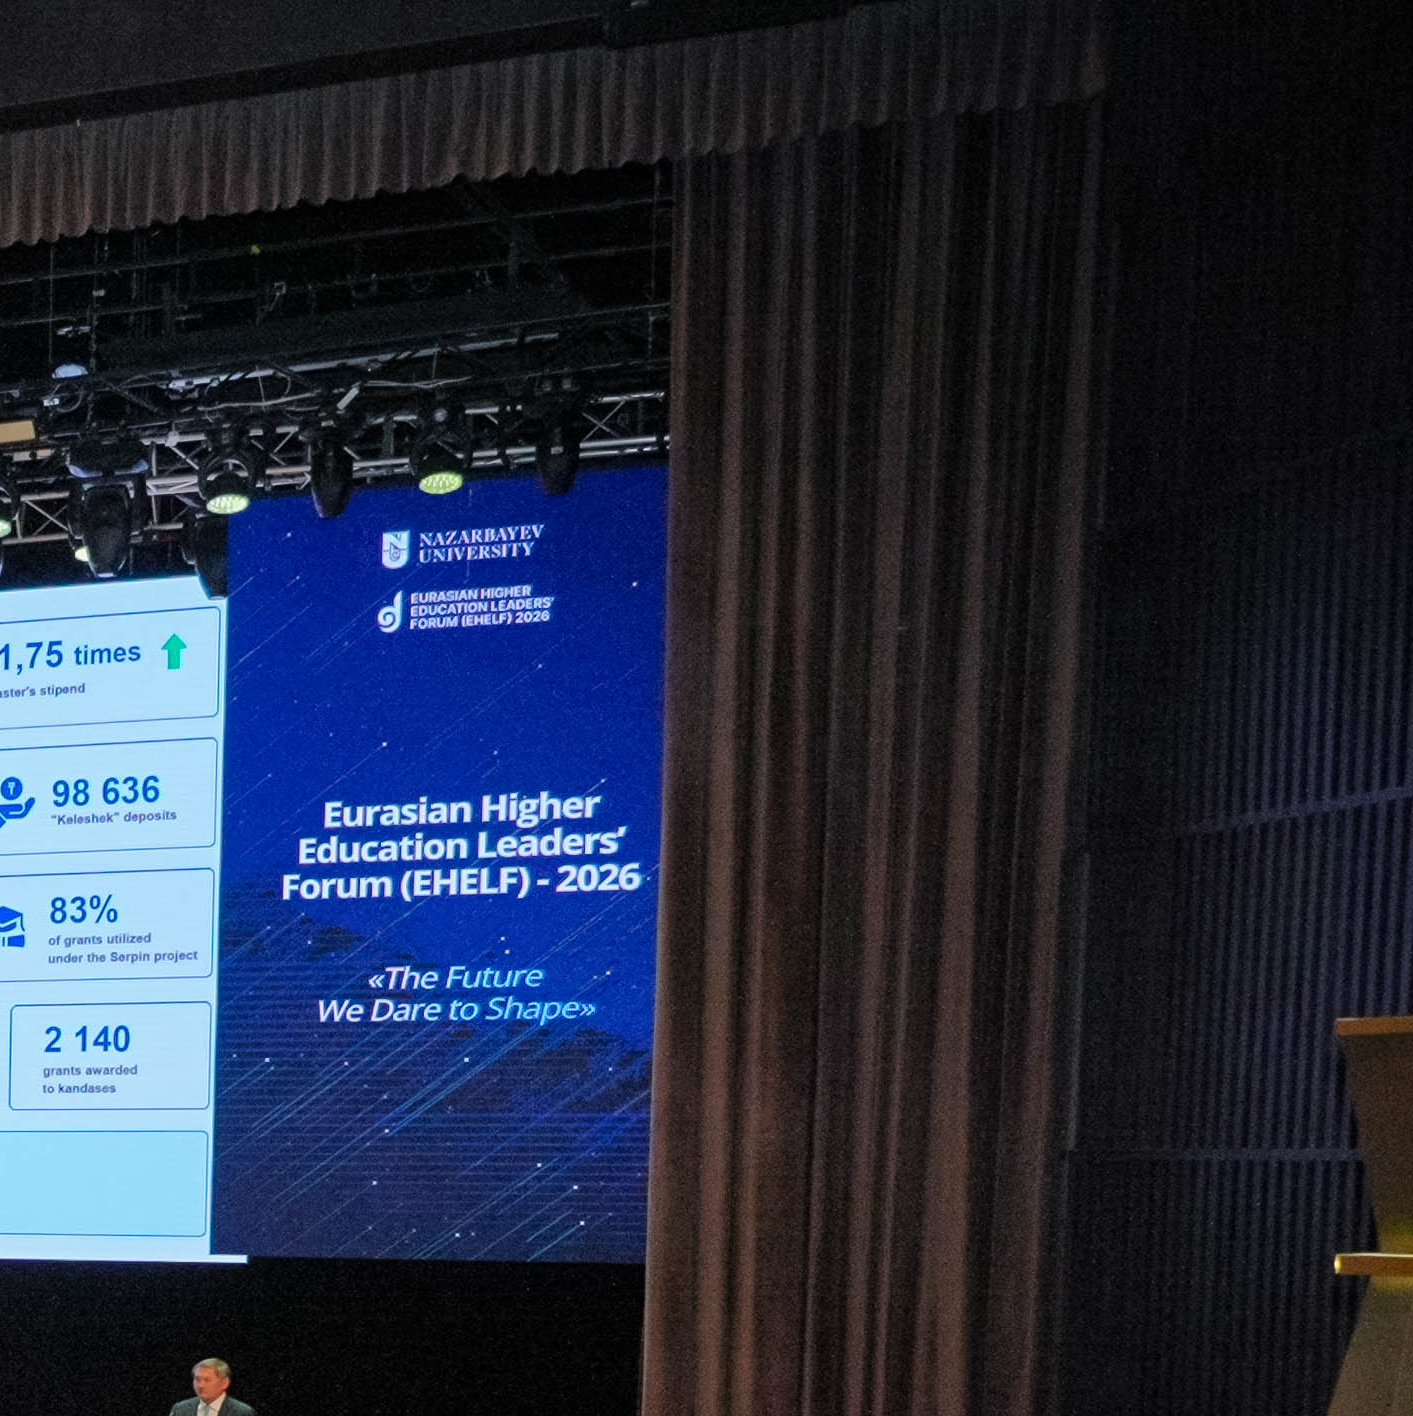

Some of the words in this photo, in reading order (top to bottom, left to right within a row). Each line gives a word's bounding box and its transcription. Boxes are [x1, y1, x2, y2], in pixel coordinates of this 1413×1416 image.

[419, 524, 545, 547] NAZARBAYEV
[419, 542, 535, 564] UNIVERSITY
[410, 588, 479, 605] EURASIAN
[481, 584, 532, 600] HIGHER
[410, 601, 488, 617] EDUCATION
[410, 615, 458, 630] FORUM
[461, 612, 512, 628] (EHELF)
[515, 610, 550, 624] 2026
[74, 641, 142, 667] times
[39, 683, 85, 699] stipend
[52, 779, 90, 808] 98
[101, 775, 160, 805] 636
[123, 809, 177, 826] deposits
[323, 797, 471, 830] Eurasian
[481, 792, 601, 831] Higher
[298, 831, 468, 866] Education
[282, 868, 391, 900] Forum
[400, 865, 531, 902] (EHELF)
[557, 862, 641, 893] 2026
[50, 894, 119, 925] 83%
[49, 934, 61, 946] of
[63, 934, 102, 949] grants
[106, 932, 152, 945] utilized
[48, 952, 83, 965] under
[86, 951, 107, 964] the
[109, 950, 151, 966] Serpin
[153, 949, 198, 965] project
[368, 966, 438, 992] «The
[445, 966, 544, 990] Future
[317, 998, 363, 1024] We
[370, 998, 442, 1022] Dare
[448, 1000, 479, 1022] to
[485, 996, 596, 1027] Shape»
[44, 1026, 62, 1053] 2
[74, 1025, 131, 1053] 140
[43, 1064, 81, 1078] grants
[85, 1063, 138, 1076] awarded
[42, 1083, 55, 1094] to
[58, 1082, 117, 1094] kandases
